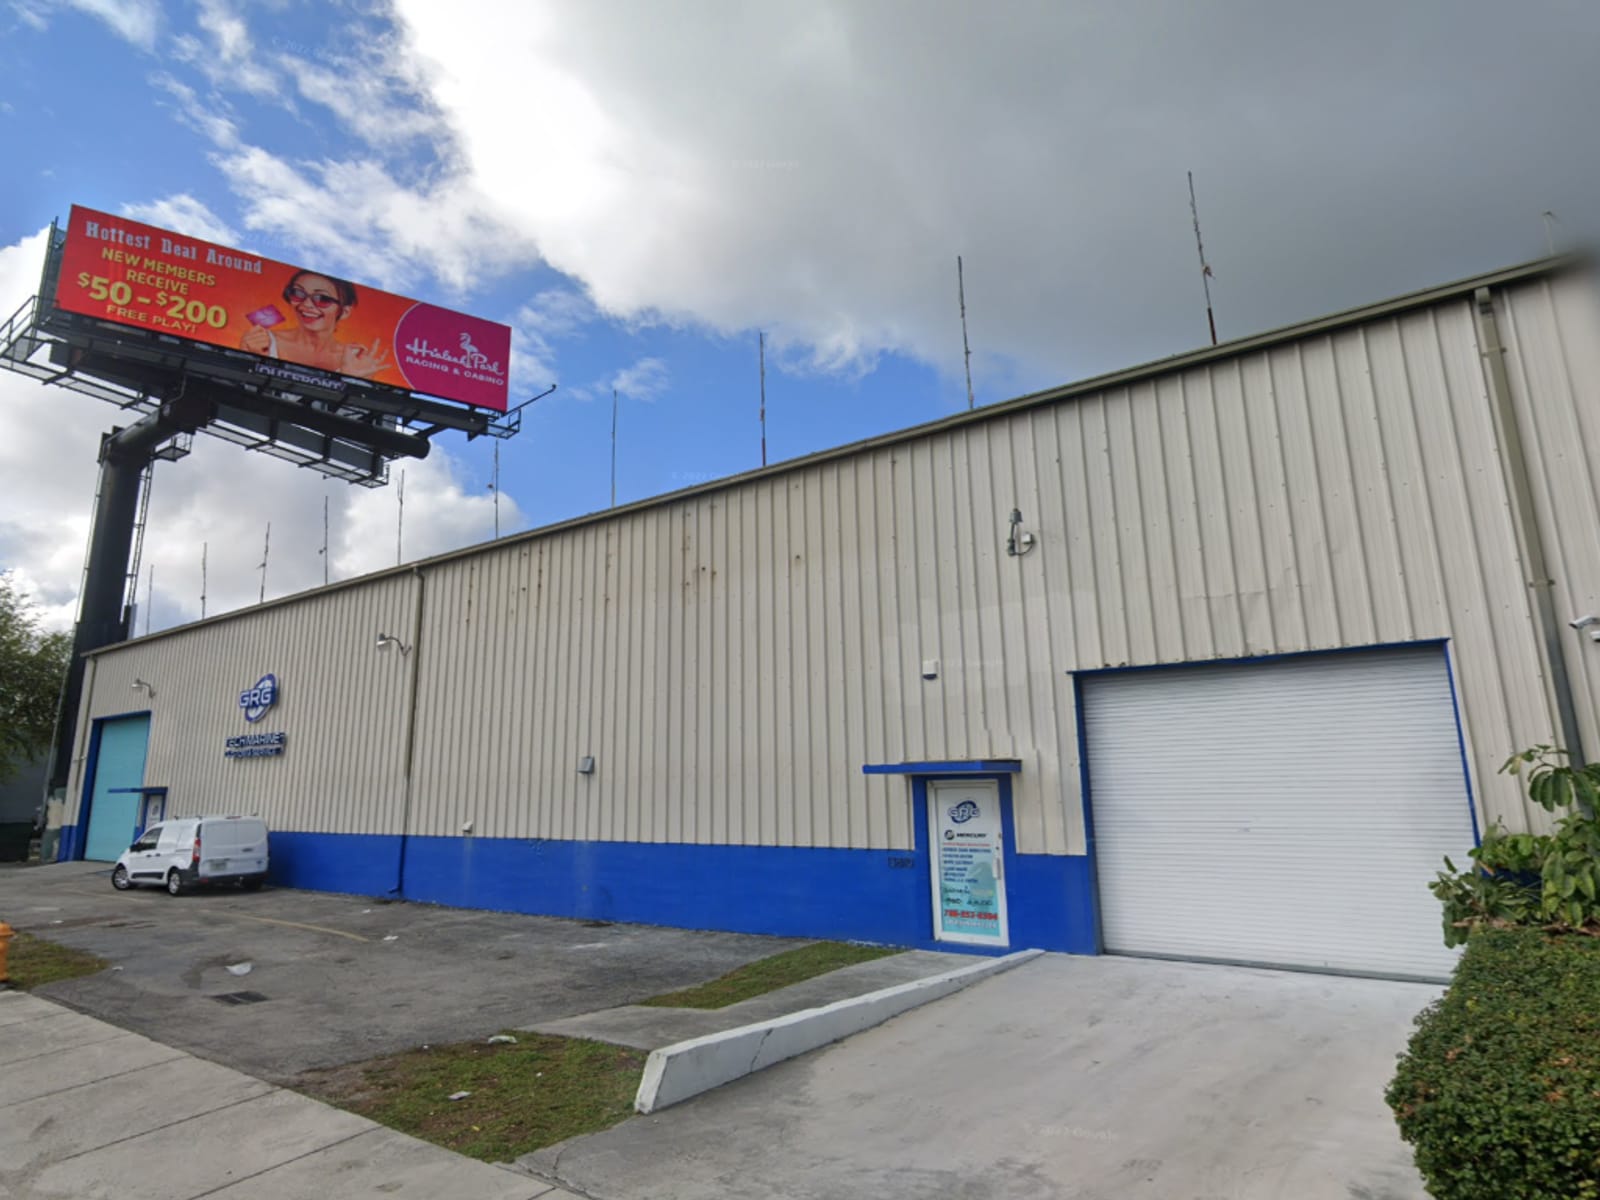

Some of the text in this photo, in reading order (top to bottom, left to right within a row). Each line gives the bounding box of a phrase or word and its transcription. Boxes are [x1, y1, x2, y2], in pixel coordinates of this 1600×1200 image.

[86, 220, 263, 274] Hottest Deal Around
[102, 248, 216, 286] NEW MEMBERS
[126, 269, 189, 295] RECEIVE
[106, 304, 197, 335] FREE PLAY!
[405, 355, 449, 373] RACING
[464, 370, 504, 386] CASINO
